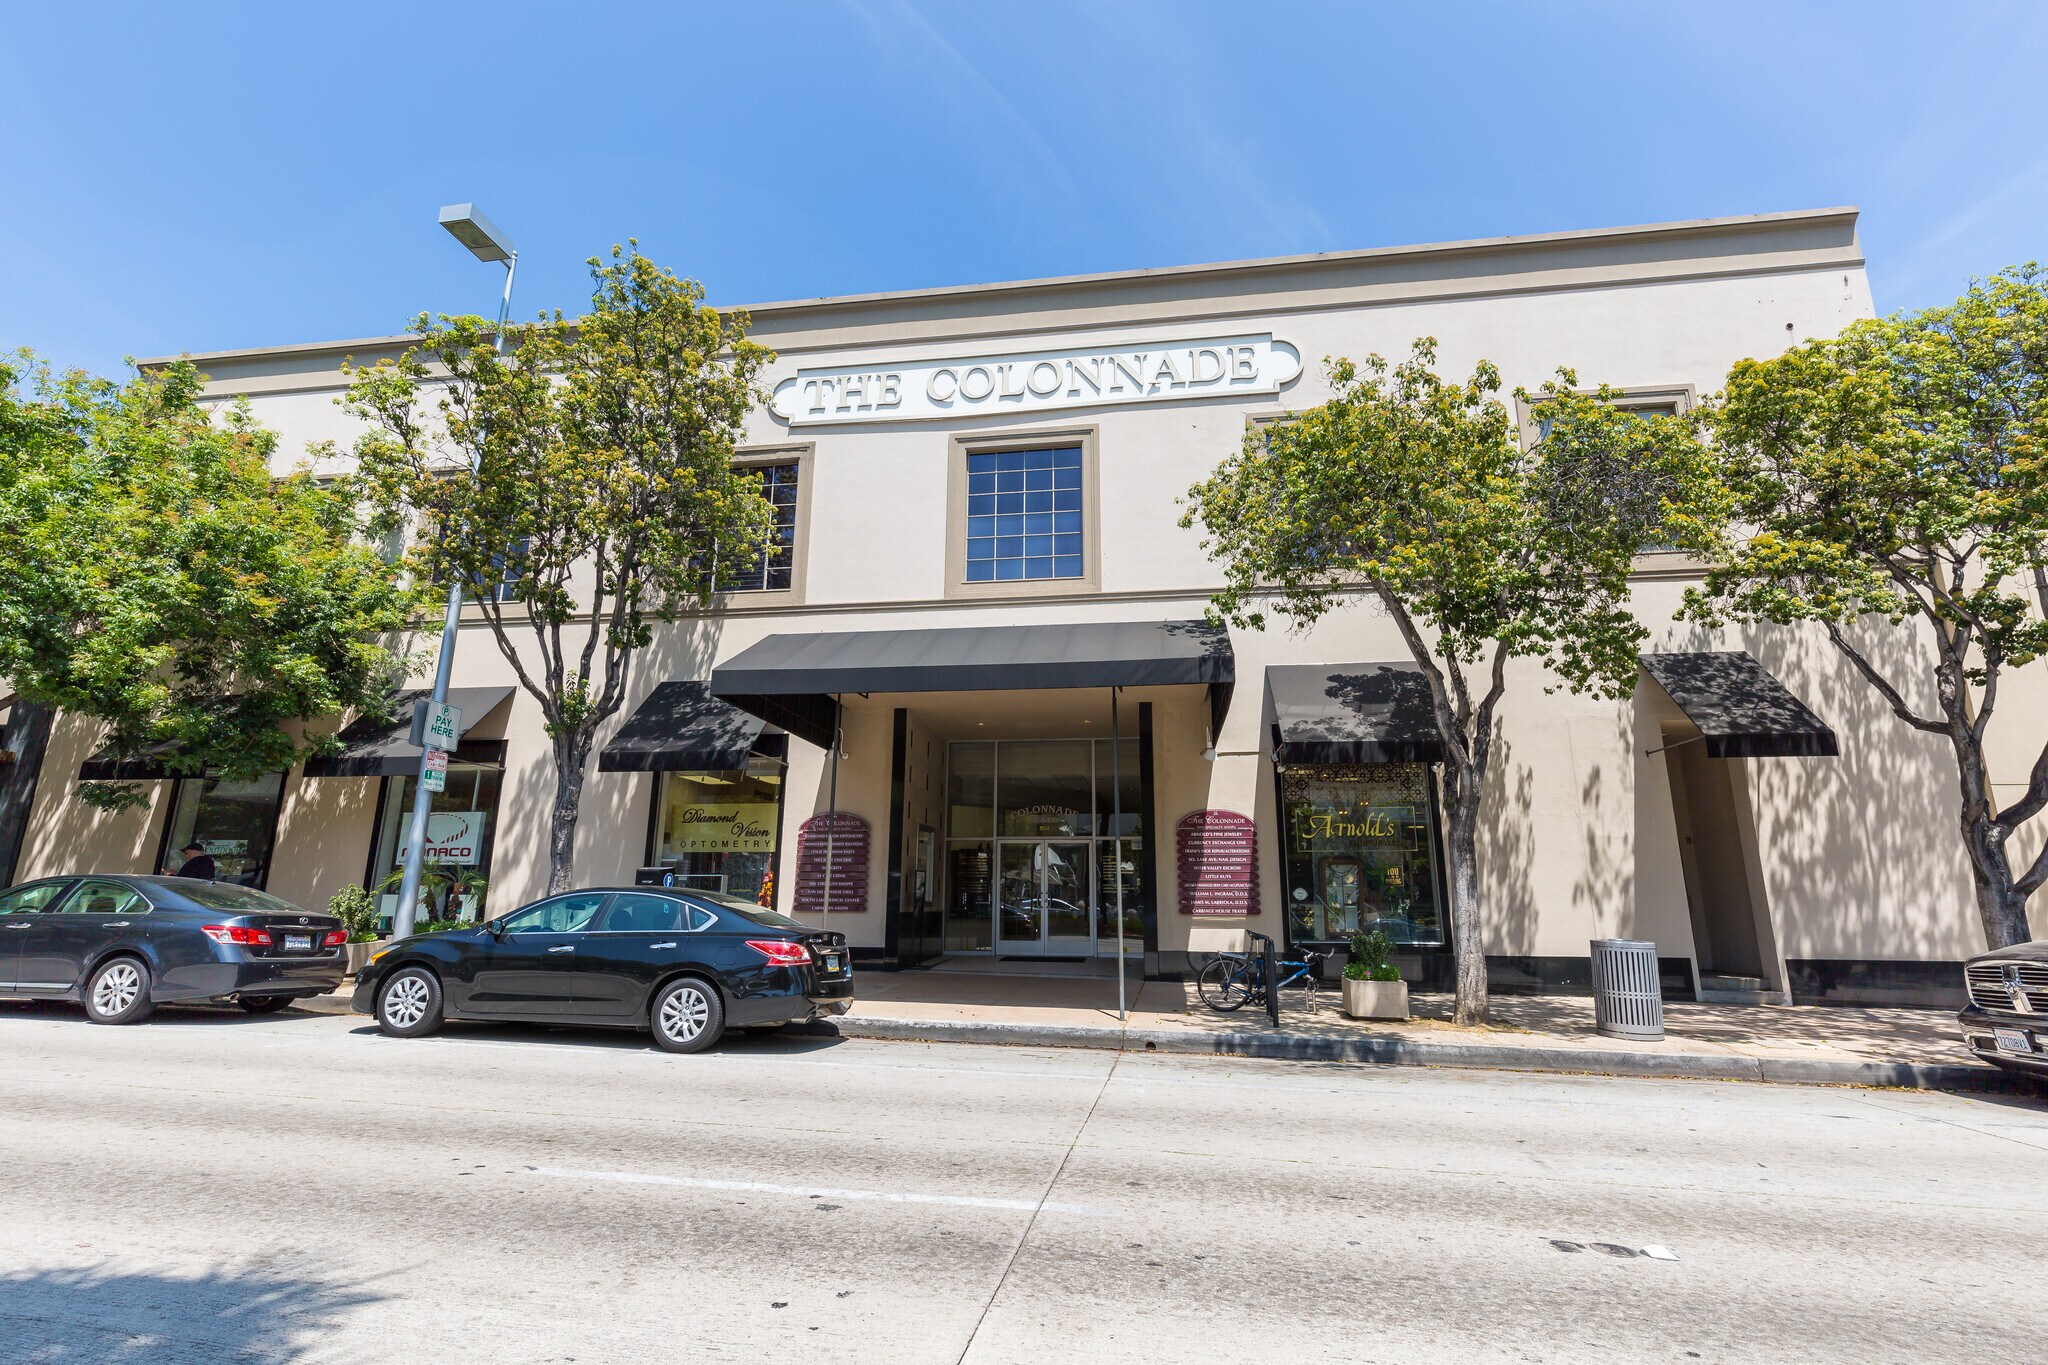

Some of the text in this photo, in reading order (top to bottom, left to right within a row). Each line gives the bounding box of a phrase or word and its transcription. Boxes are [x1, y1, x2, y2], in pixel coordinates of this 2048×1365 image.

[804, 345, 1259, 410] THE COLONNADE
[435, 715, 453, 728] PAY
[430, 724, 454, 739] HERE
[681, 808, 740, 824] Diamond
[1205, 814, 1246, 825] COLONNADE
[730, 821, 771, 839] Vision
[1301, 811, 1395, 839] Arnold's
[401, 847, 472, 857] NACO
[680, 840, 771, 849] OPTOMETRY
